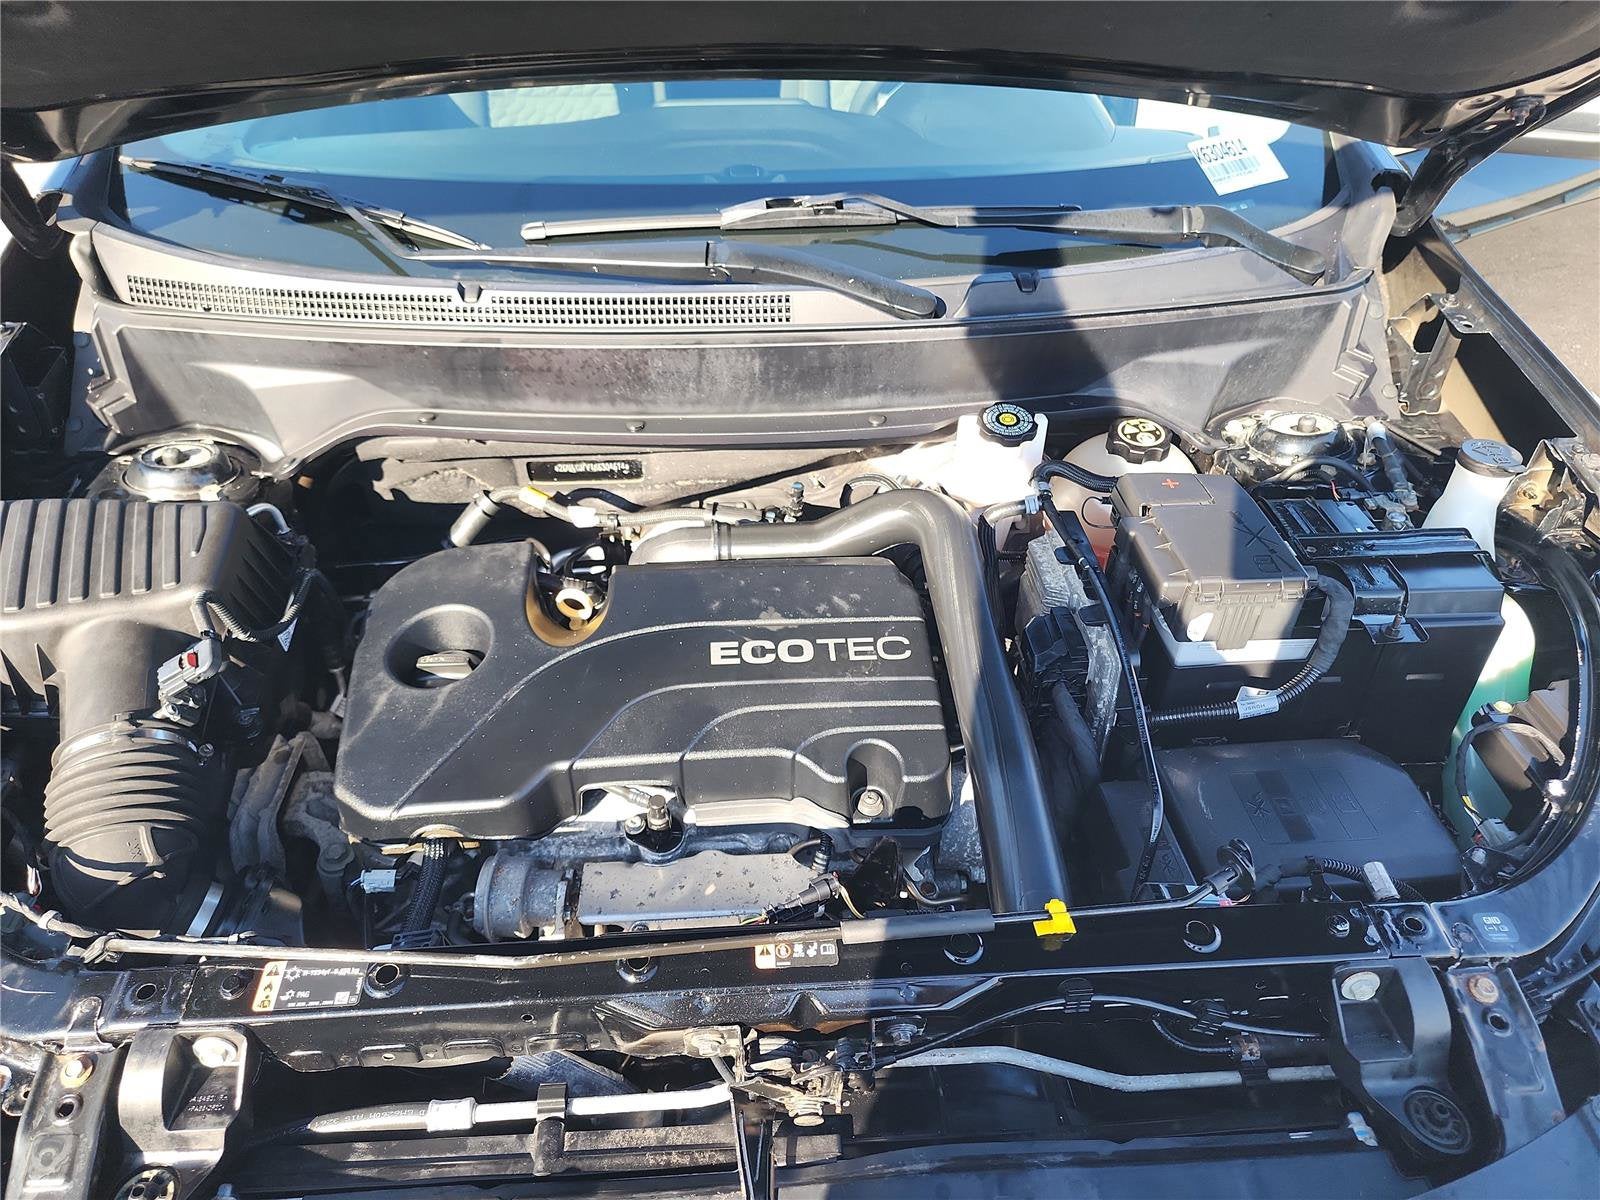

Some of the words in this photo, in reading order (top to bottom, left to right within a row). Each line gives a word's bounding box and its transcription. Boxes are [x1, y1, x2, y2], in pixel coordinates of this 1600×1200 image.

[1192, 138, 1249, 164] K6304614
[709, 636, 912, 665] ECOTEC
[296, 990, 311, 999] PAG
